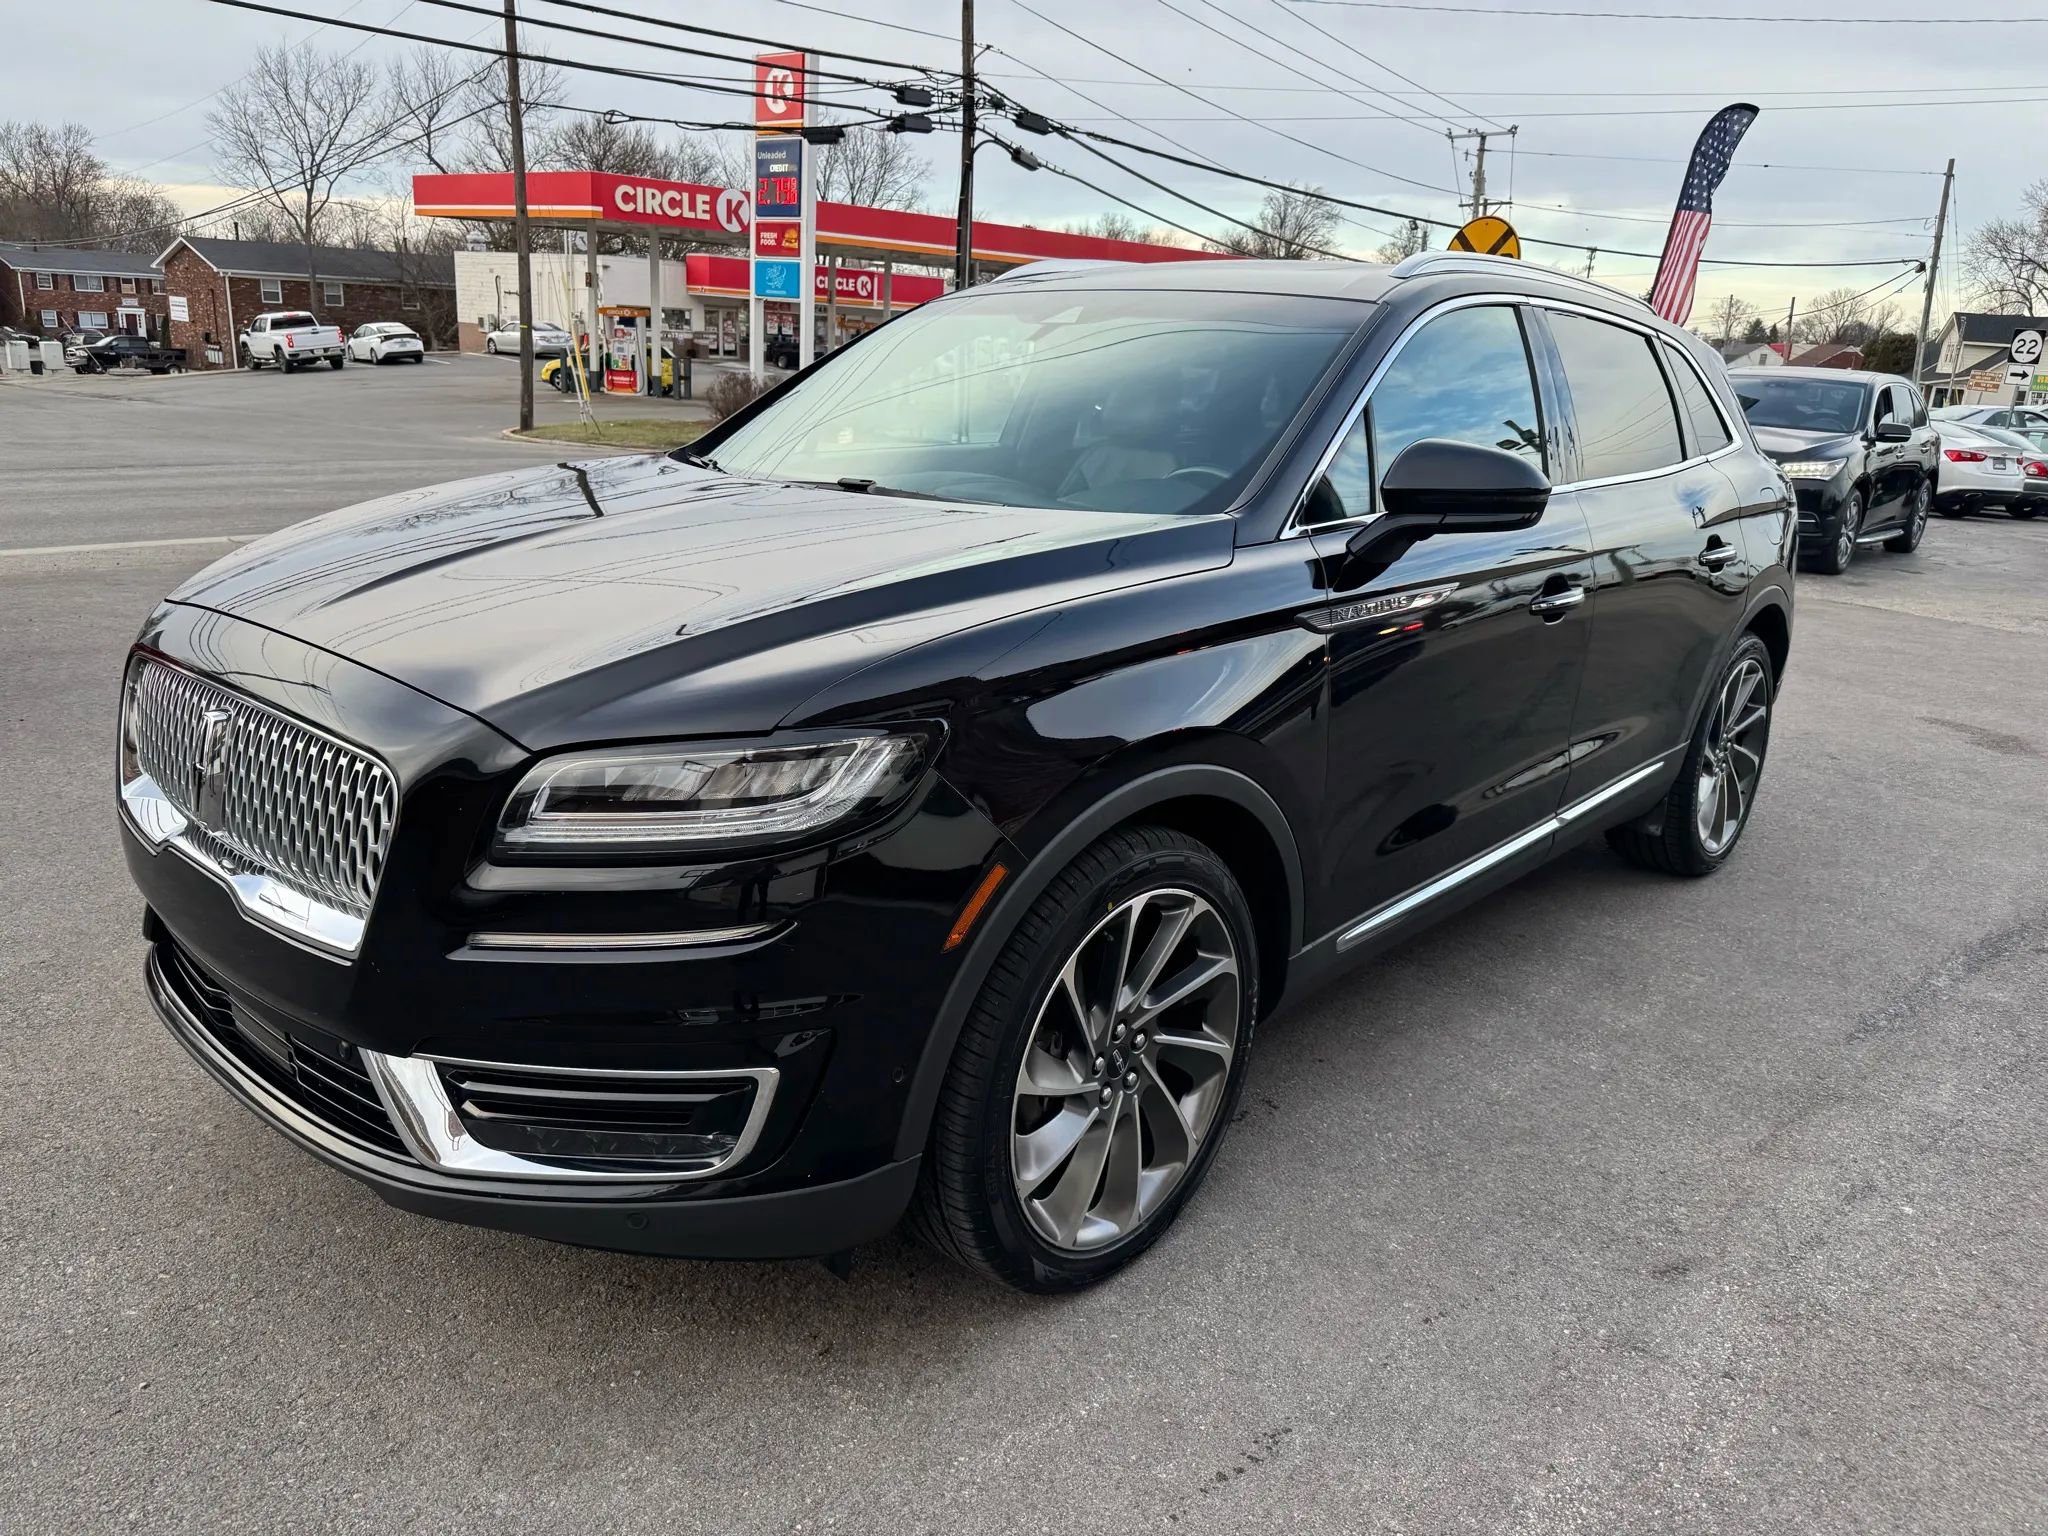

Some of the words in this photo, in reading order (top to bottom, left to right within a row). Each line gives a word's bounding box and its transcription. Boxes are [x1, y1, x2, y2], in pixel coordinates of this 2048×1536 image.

[757, 151, 787, 160] Unleaded
[615, 185, 711, 221] CIRCLE
[816, 276, 856, 291] CICLE
[2014, 338, 2039, 354] 22
[1337, 596, 1408, 620] NAUTILUS
